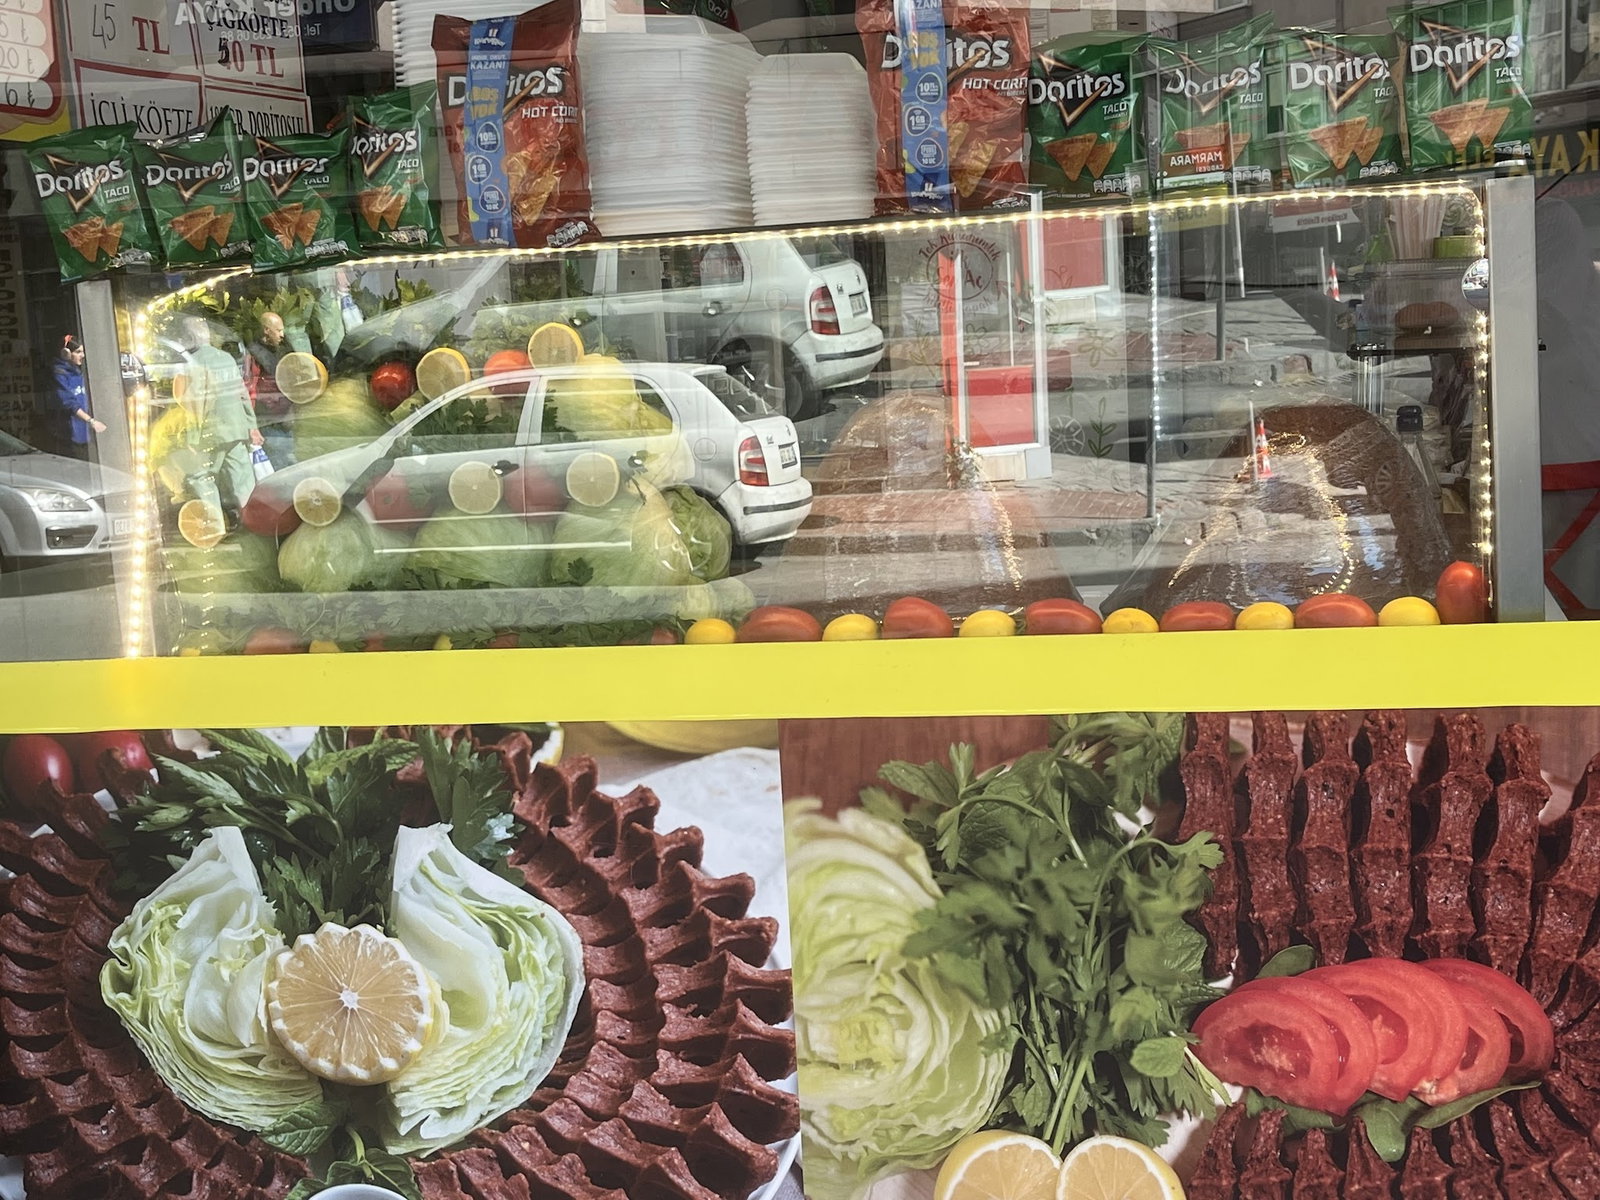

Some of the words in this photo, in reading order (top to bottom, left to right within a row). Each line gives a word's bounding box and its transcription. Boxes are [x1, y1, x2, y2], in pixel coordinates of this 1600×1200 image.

[92, 3, 116, 48] 45
[132, 16, 170, 55] TL
[251, 43, 285, 78] TL
[882, 33, 1011, 69] Ditos
[1409, 34, 1521, 73] Doritos
[448, 66, 563, 107] Ditos
[963, 78, 991, 89] HOT
[1494, 67, 1522, 78] TACO
[1028, 73, 1126, 105] Doritos
[1239, 92, 1264, 104] TACO
[133, 101, 193, 136] KÖFTE
[521, 106, 549, 119] HOT
[1102, 101, 1128, 115] TACO
[35, 160, 124, 198] Doritos
[146, 153, 232, 186] Doritos
[243, 157, 329, 182] Doritos
[104, 185, 130, 199] TACO
